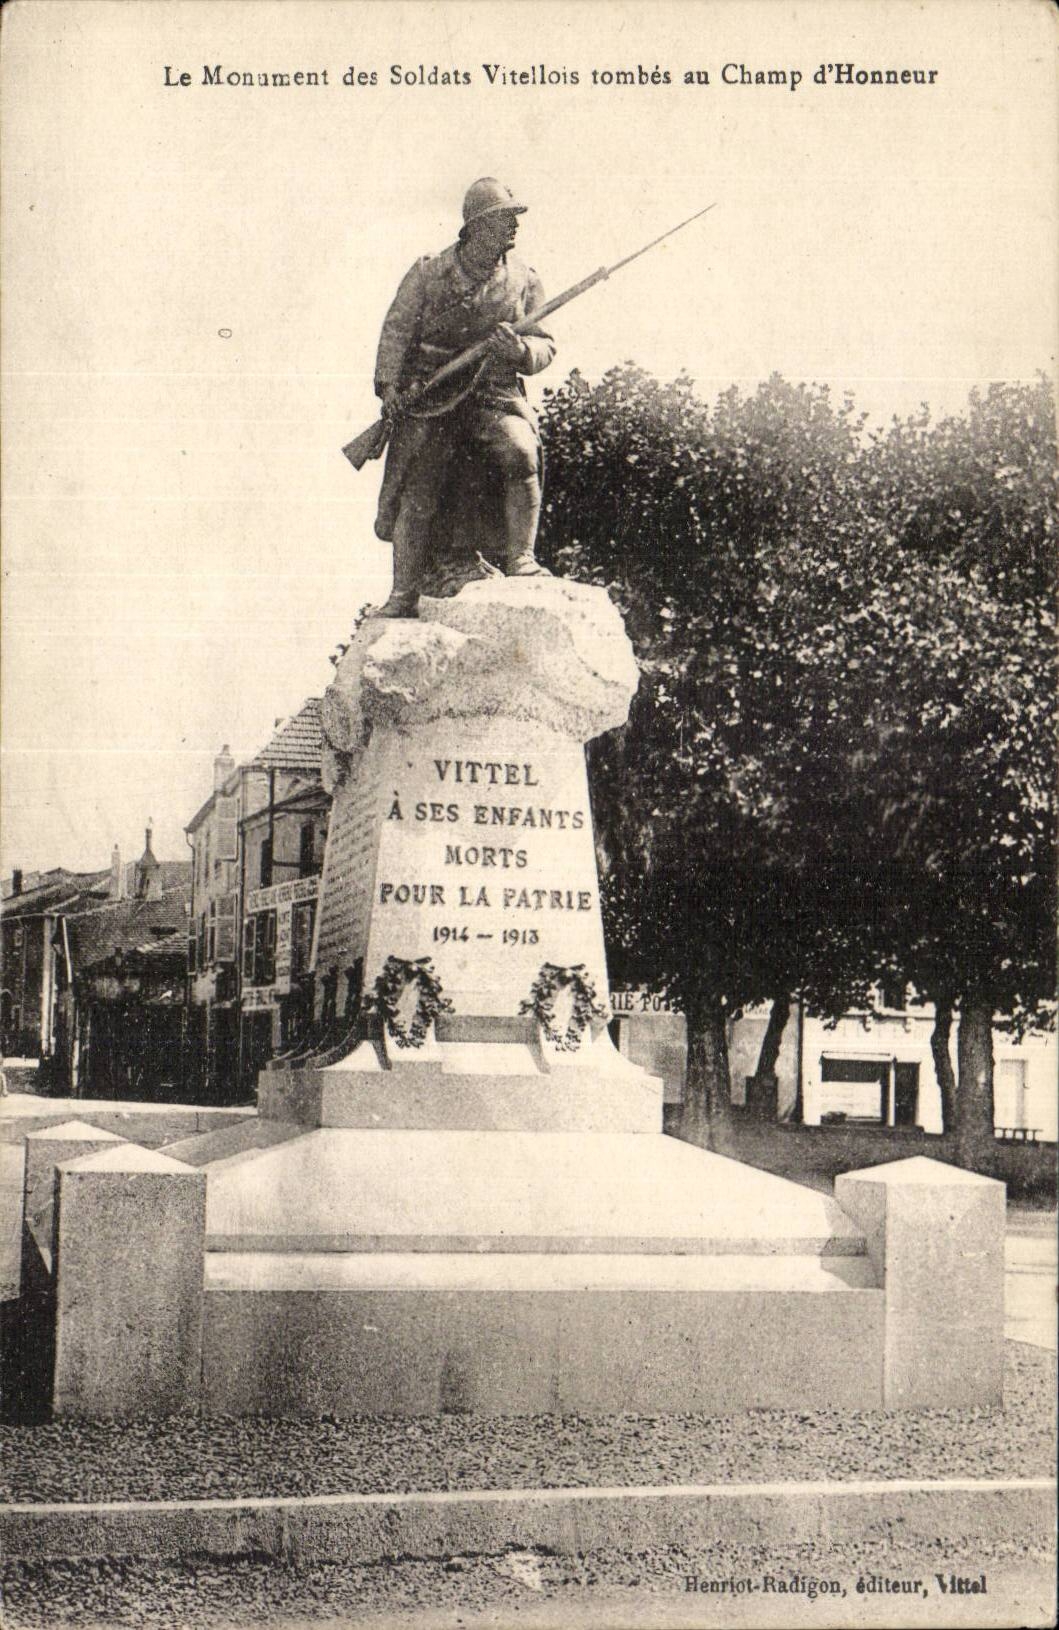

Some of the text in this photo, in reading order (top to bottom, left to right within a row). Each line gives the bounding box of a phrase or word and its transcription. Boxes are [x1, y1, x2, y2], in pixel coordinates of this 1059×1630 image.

[433, 759, 540, 787] VITTEL
[386, 790, 586, 830] À SES ENFANTS
[444, 844, 528, 869] MORTS
[378, 882, 593, 913] POUR LA PATRIE
[432, 926, 469, 945] 1914
